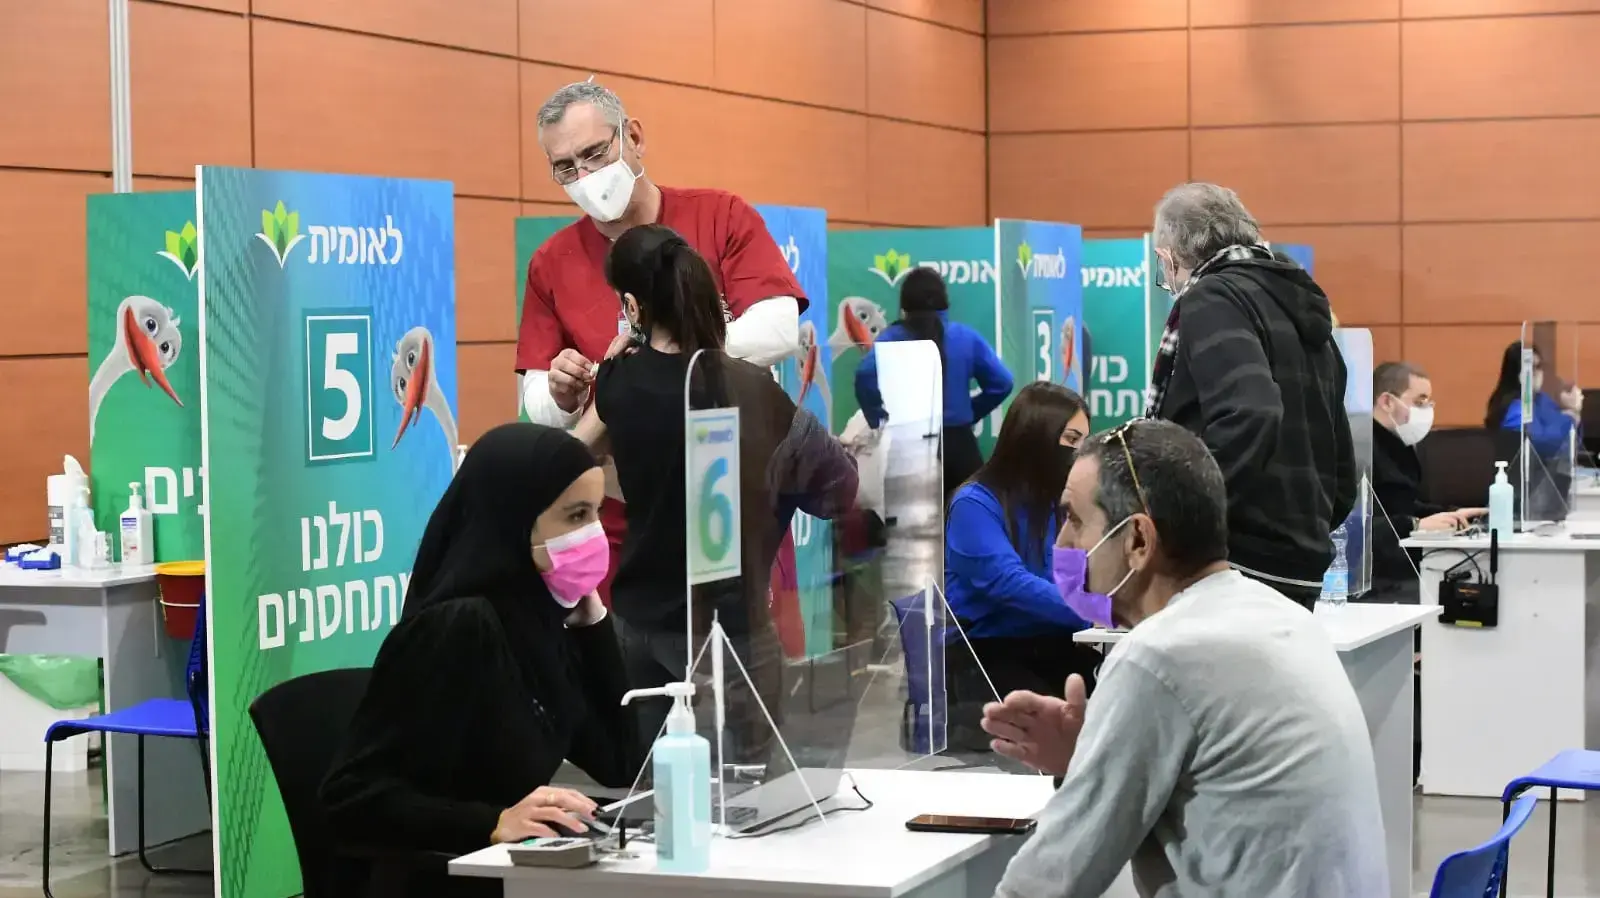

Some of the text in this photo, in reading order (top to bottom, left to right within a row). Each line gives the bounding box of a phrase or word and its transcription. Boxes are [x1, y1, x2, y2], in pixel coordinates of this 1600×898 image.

[307, 214, 403, 266] לאומית
[918, 259, 996, 284] אומי
[1037, 320, 1052, 381] 3
[323, 332, 362, 440] 5
[301, 501, 385, 572] כולנו
[700, 457, 732, 562] 6
